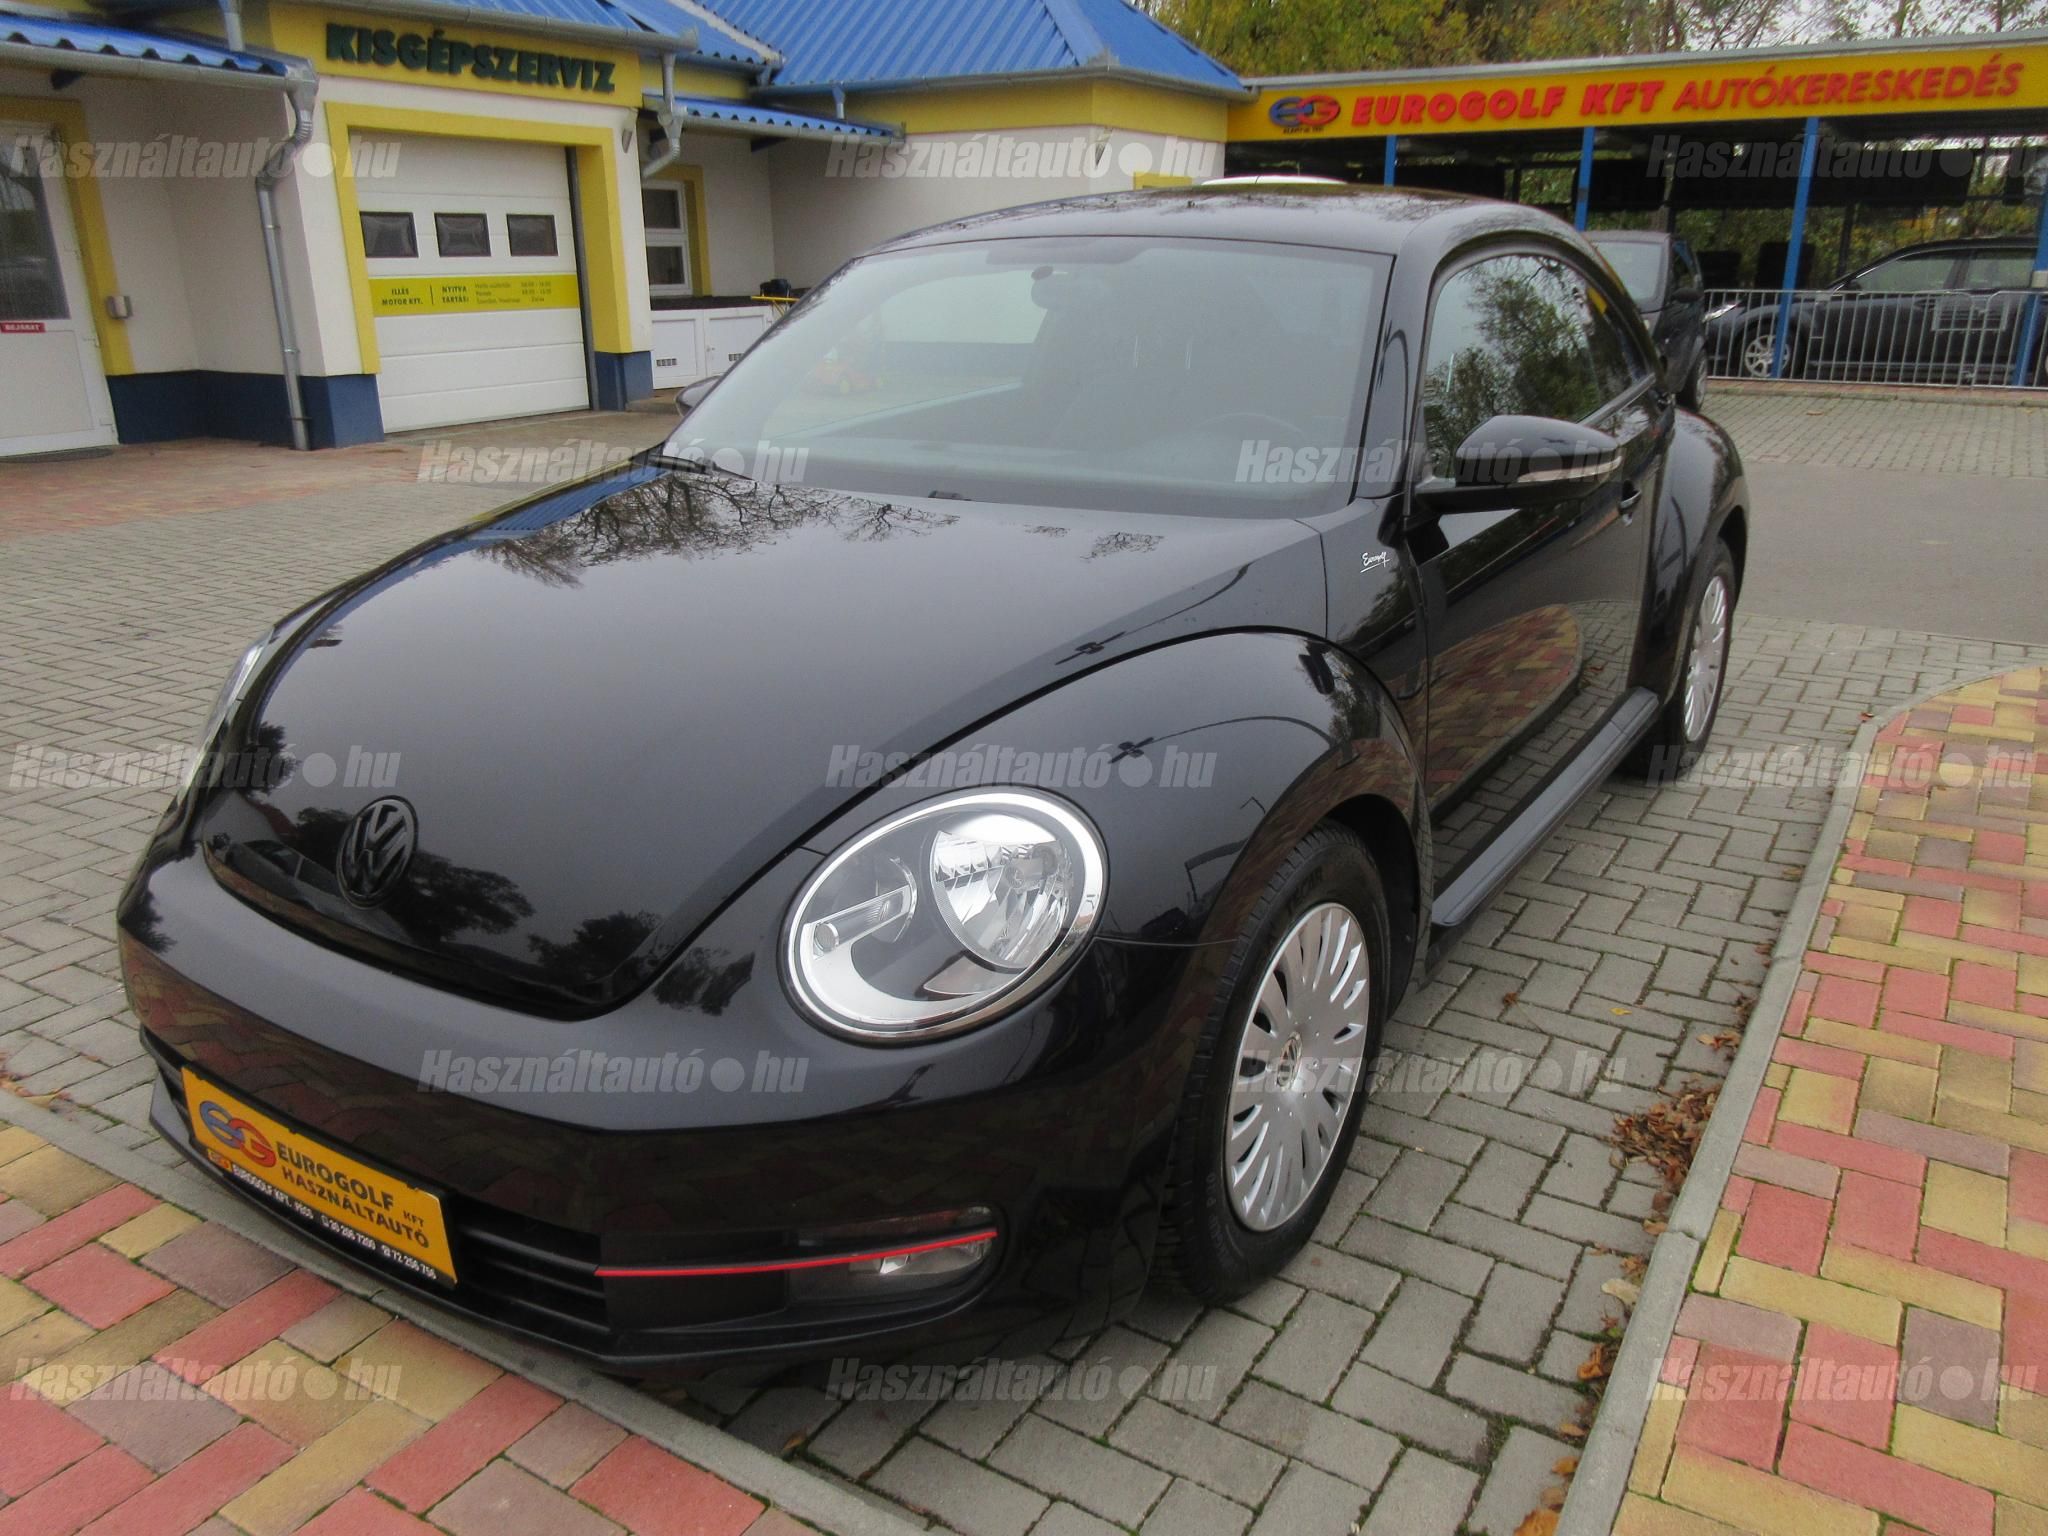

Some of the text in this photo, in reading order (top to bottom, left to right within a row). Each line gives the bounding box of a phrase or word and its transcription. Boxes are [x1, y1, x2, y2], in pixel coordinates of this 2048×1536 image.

[326, 22, 616, 94] KISGÉPSZERVIZ
[1351, 53, 2025, 127] EUROGOLF KFT AUTÓKERESKEDÉS
[276, 1140, 394, 1212] EUROGOLF
[403, 1209, 425, 1228] KFT
[281, 1165, 430, 1249] HASZNÁLTAUTÓ
